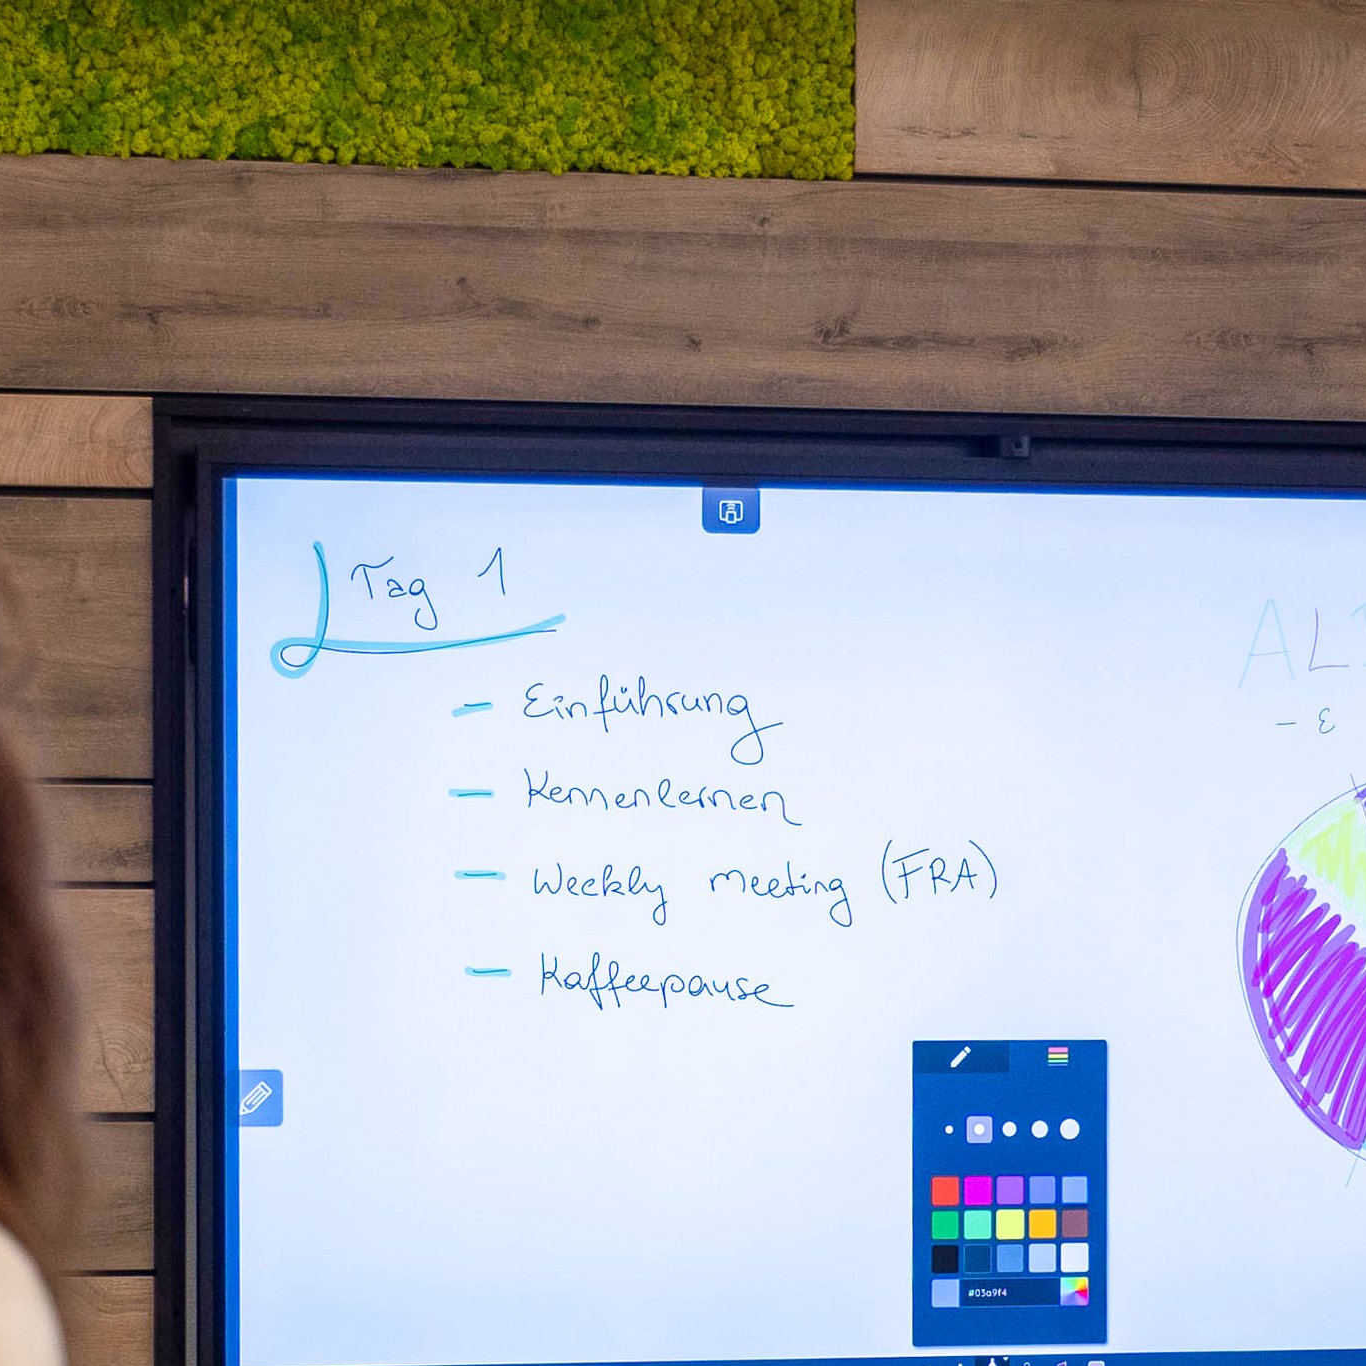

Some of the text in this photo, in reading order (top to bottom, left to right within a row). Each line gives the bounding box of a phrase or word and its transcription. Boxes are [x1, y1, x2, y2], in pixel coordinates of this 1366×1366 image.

[350, 546, 506, 631] Tag 1
[522, 673, 785, 766] Einführung
[523, 767, 803, 827] Kennenlernen
[533, 861, 669, 926] Weekly
[881, 839, 998, 905] (FRA)
[540, 950, 795, 1011] Kaffeepause
